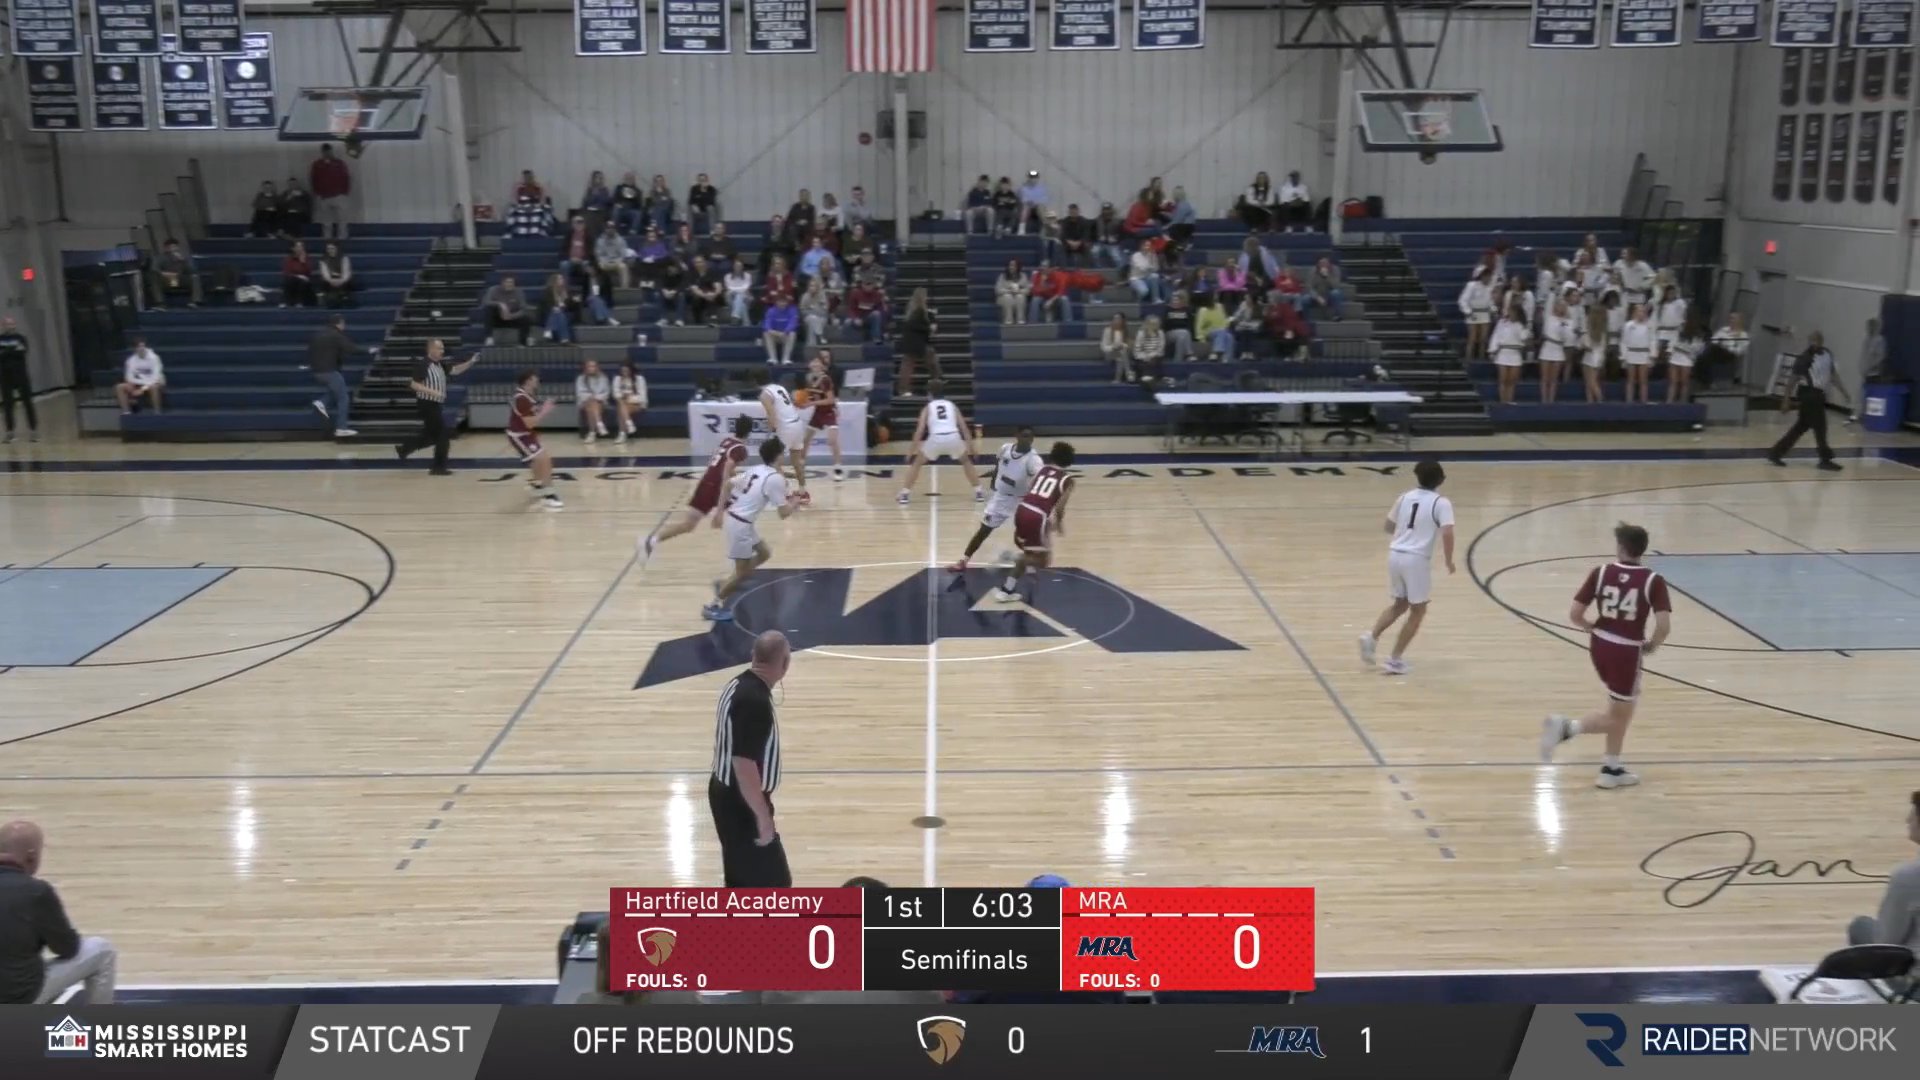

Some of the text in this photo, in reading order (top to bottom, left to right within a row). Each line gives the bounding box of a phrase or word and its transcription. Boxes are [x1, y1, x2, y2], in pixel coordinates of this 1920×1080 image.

[936, 405, 947, 420] 2
[1031, 475, 1059, 499] 10
[1407, 502, 1419, 529] 1
[1602, 585, 1639, 621] 24
